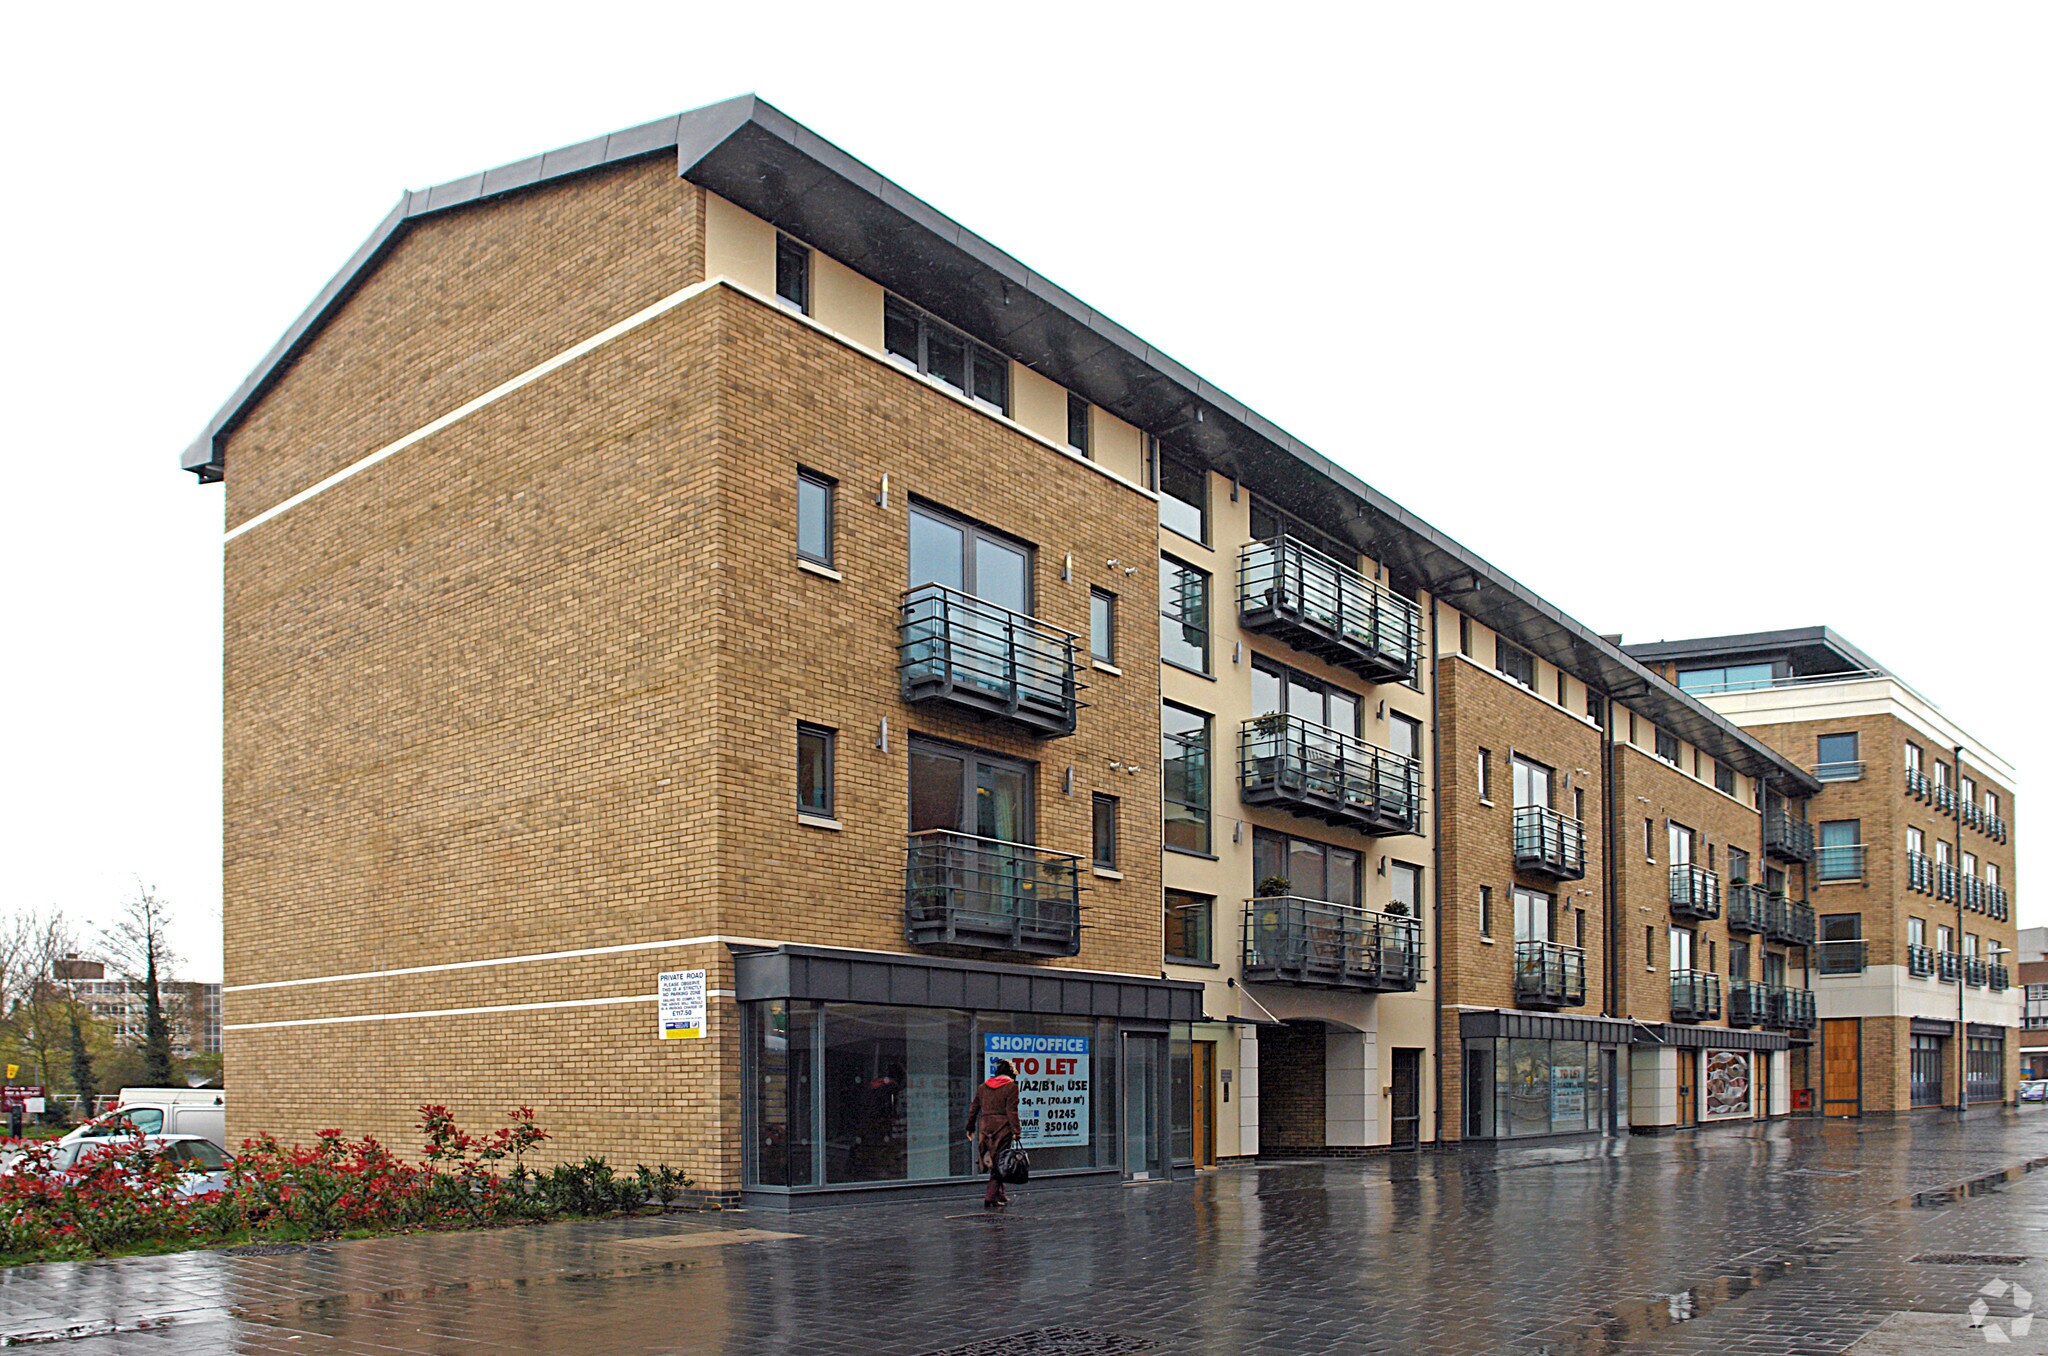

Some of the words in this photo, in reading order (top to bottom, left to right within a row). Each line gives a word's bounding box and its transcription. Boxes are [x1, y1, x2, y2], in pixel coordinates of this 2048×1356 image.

[991, 1037, 1083, 1052] SHOP/OFFICE
[1012, 1058, 1039, 1075] TO
[1046, 1058, 1077, 1075] LET
[1559, 1069, 1568, 1078] TO
[1570, 1069, 1581, 1078] LET
[1018, 1081, 1064, 1092] /A2/B1(a)
[1068, 1081, 1087, 1090] USE
[1022, 1097, 1033, 1106] Sq.
[1049, 1097, 1071, 1105] (70.63
[1048, 1110, 1075, 1119] 01245
[1045, 1122, 1078, 1132] 350160
